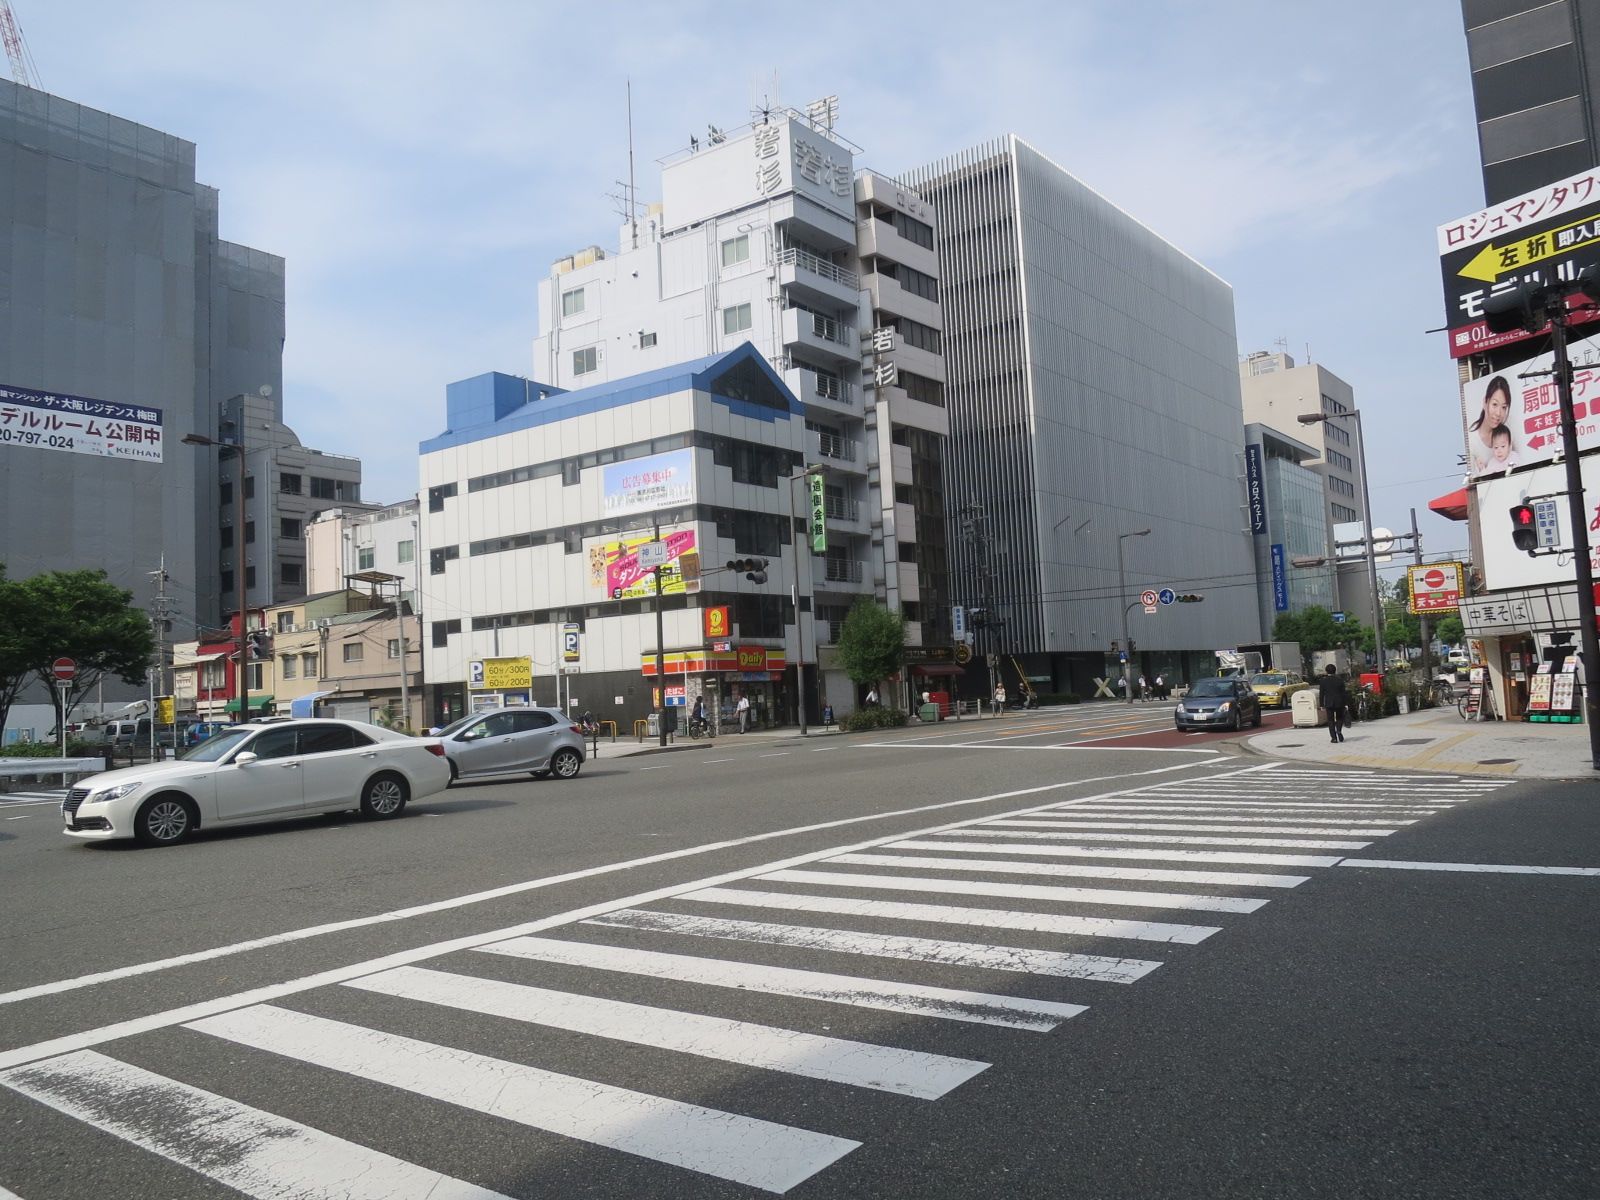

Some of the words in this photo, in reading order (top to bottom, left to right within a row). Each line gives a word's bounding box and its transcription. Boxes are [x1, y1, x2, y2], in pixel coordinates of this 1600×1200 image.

[1446, 176, 1600, 246] ロジュマンタワ
[1499, 234, 1547, 267] 左折
[873, 328, 894, 386] 若杉
[0, 428, 74, 449] 0-797-024
[116, 447, 161, 459] KEIHAN
[622, 468, 671, 489] 広告募集中
[1252, 480, 1263, 530] クロス・ウェーブ
[1416, 594, 1457, 608] 天下一品
[1469, 602, 1527, 624] 中華そば
[740, 651, 764, 666] Daily
